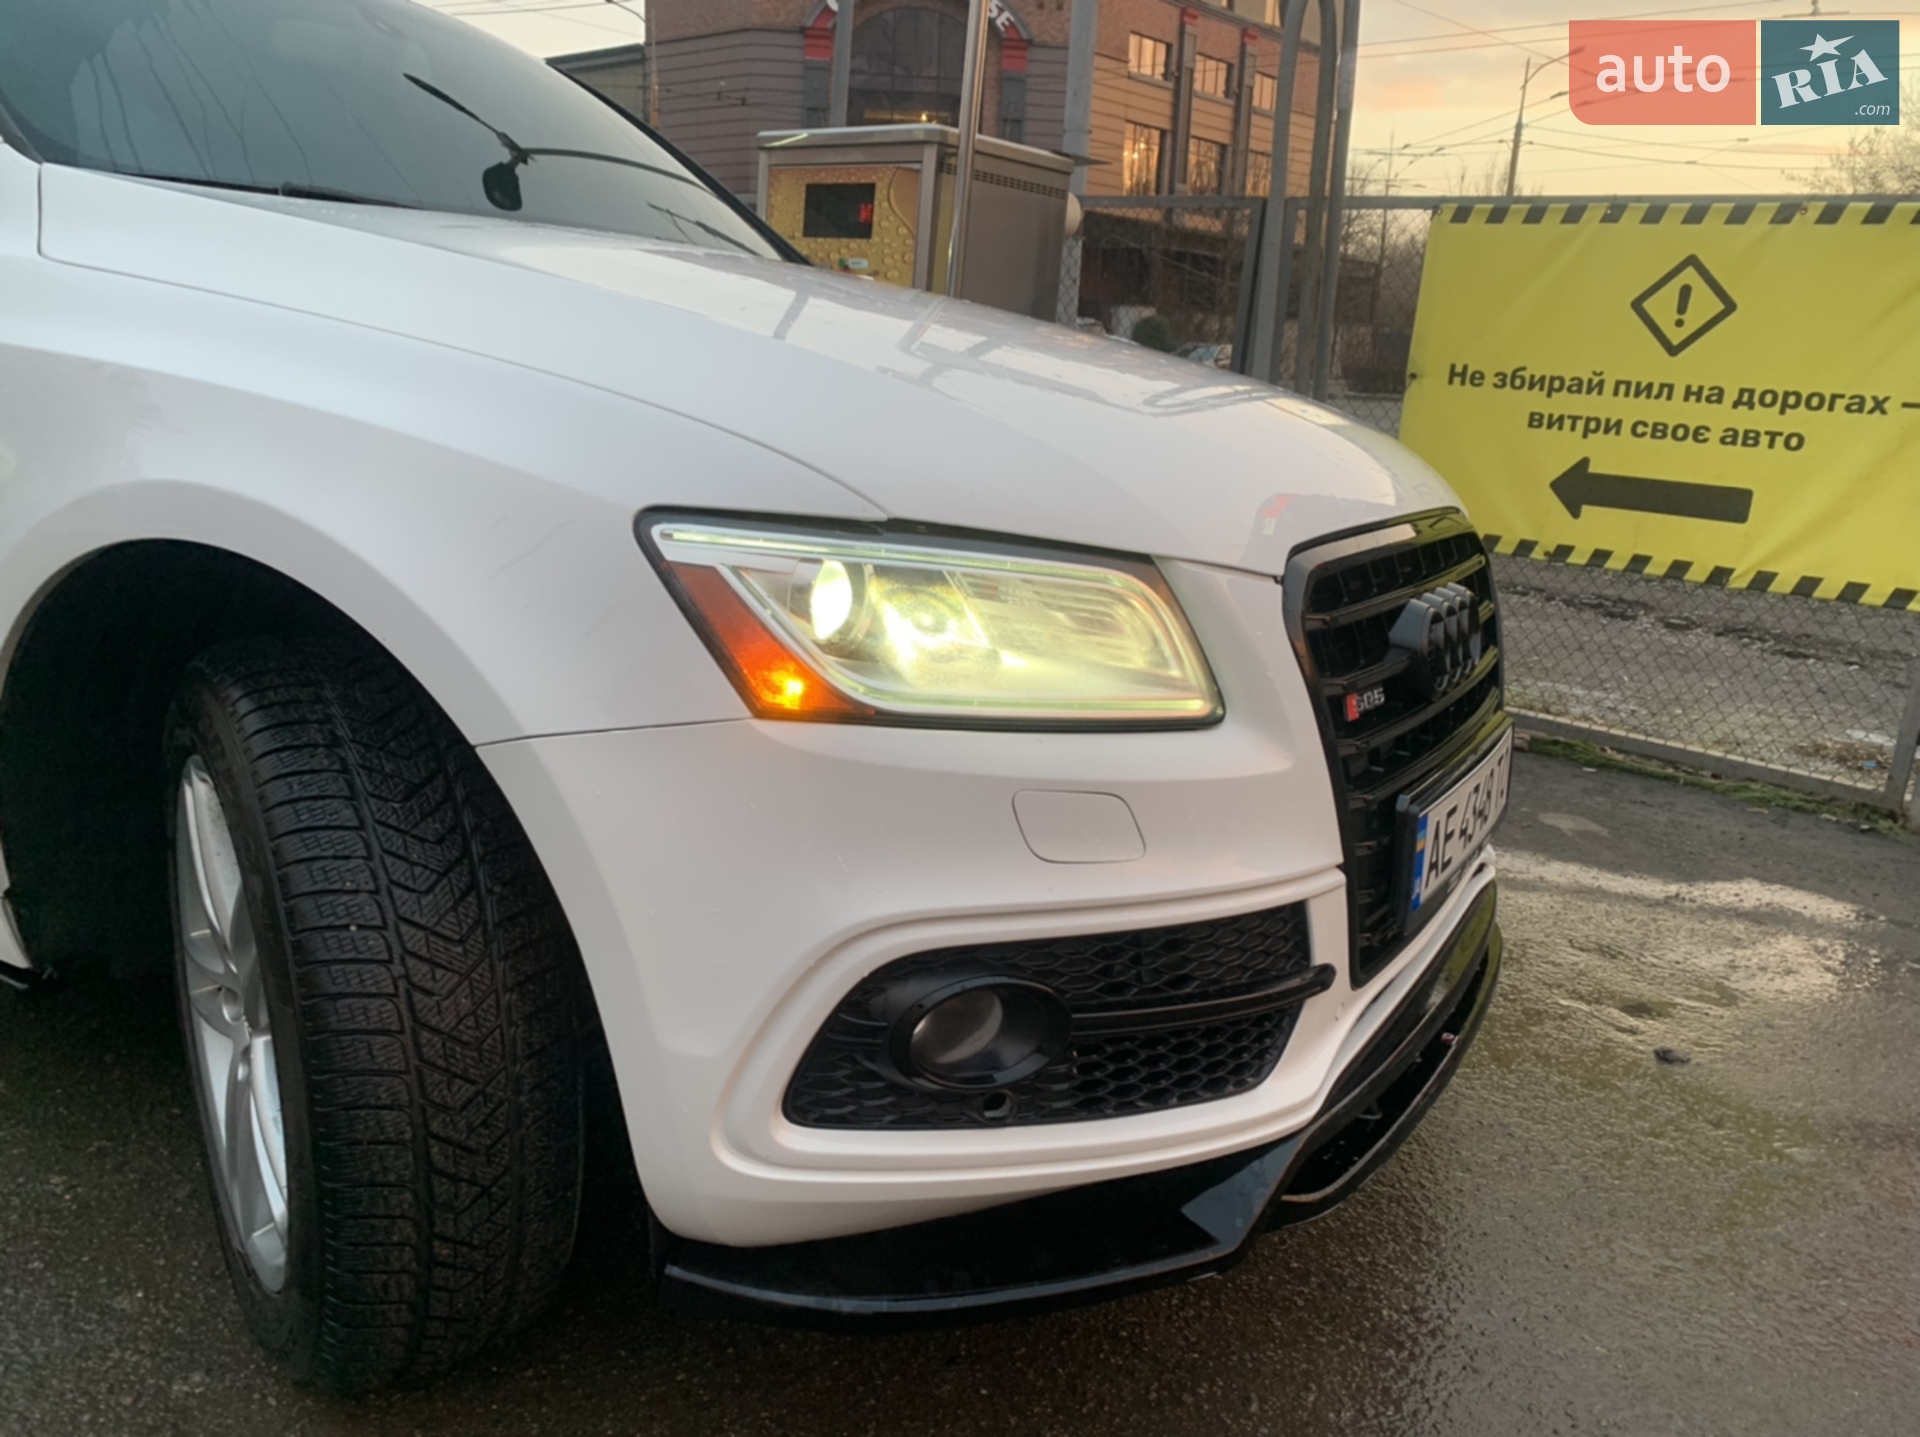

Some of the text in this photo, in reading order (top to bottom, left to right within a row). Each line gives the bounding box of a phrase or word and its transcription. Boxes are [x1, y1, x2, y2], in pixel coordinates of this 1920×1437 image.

[1447, 362, 1486, 388] Не
[1492, 366, 1606, 399] збирай
[1612, 379, 1675, 402] пил
[1683, 384, 1725, 405] на
[1731, 387, 1891, 416] дорогах
[1527, 411, 1805, 452] витри своє авто
[1424, 803, 1459, 890] AE
